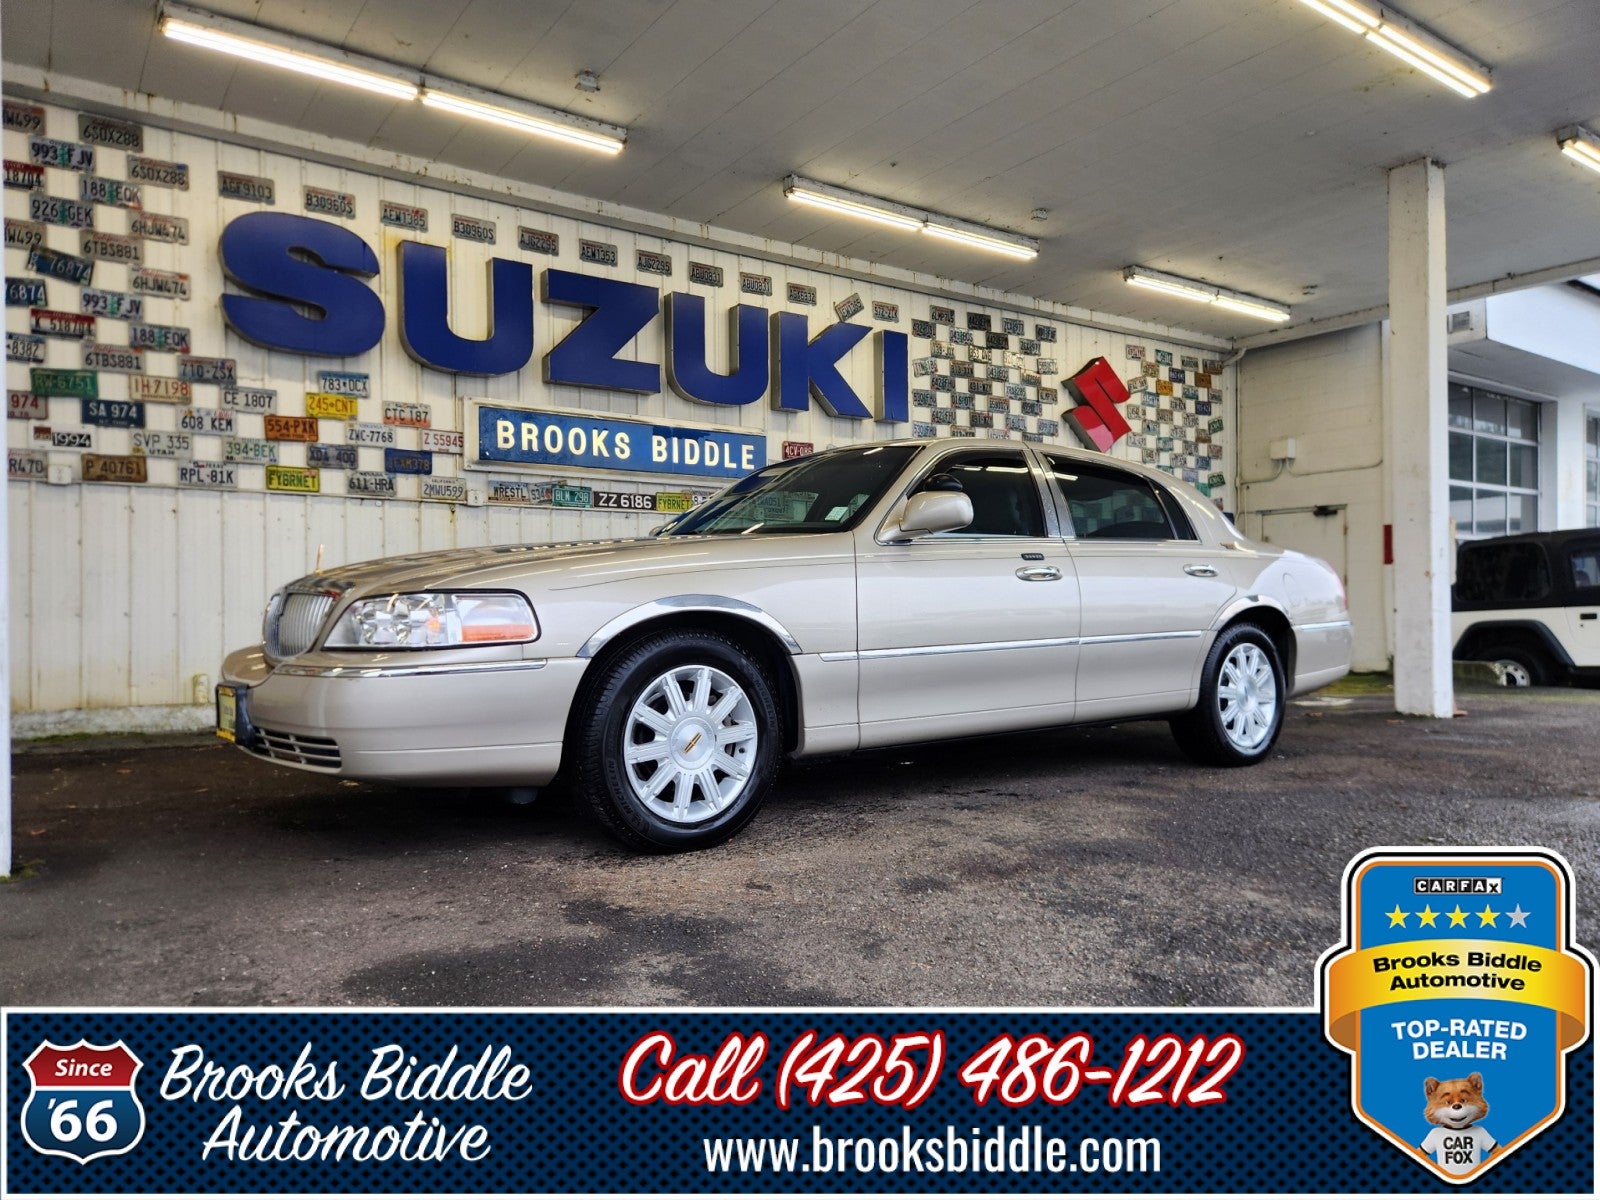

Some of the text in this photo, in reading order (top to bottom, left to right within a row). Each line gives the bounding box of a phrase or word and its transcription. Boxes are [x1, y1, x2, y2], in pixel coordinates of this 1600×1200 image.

[219, 211, 908, 423] SUZUKI
[110, 403, 137, 418] 974
[410, 410, 429, 423] 187
[181, 416, 204, 431] 608
[52, 432, 91, 448] 1994
[167, 435, 190, 450] 335
[497, 419, 755, 470] BROOKS BIDDLE
[598, 493, 652, 509] ZZ 6186
